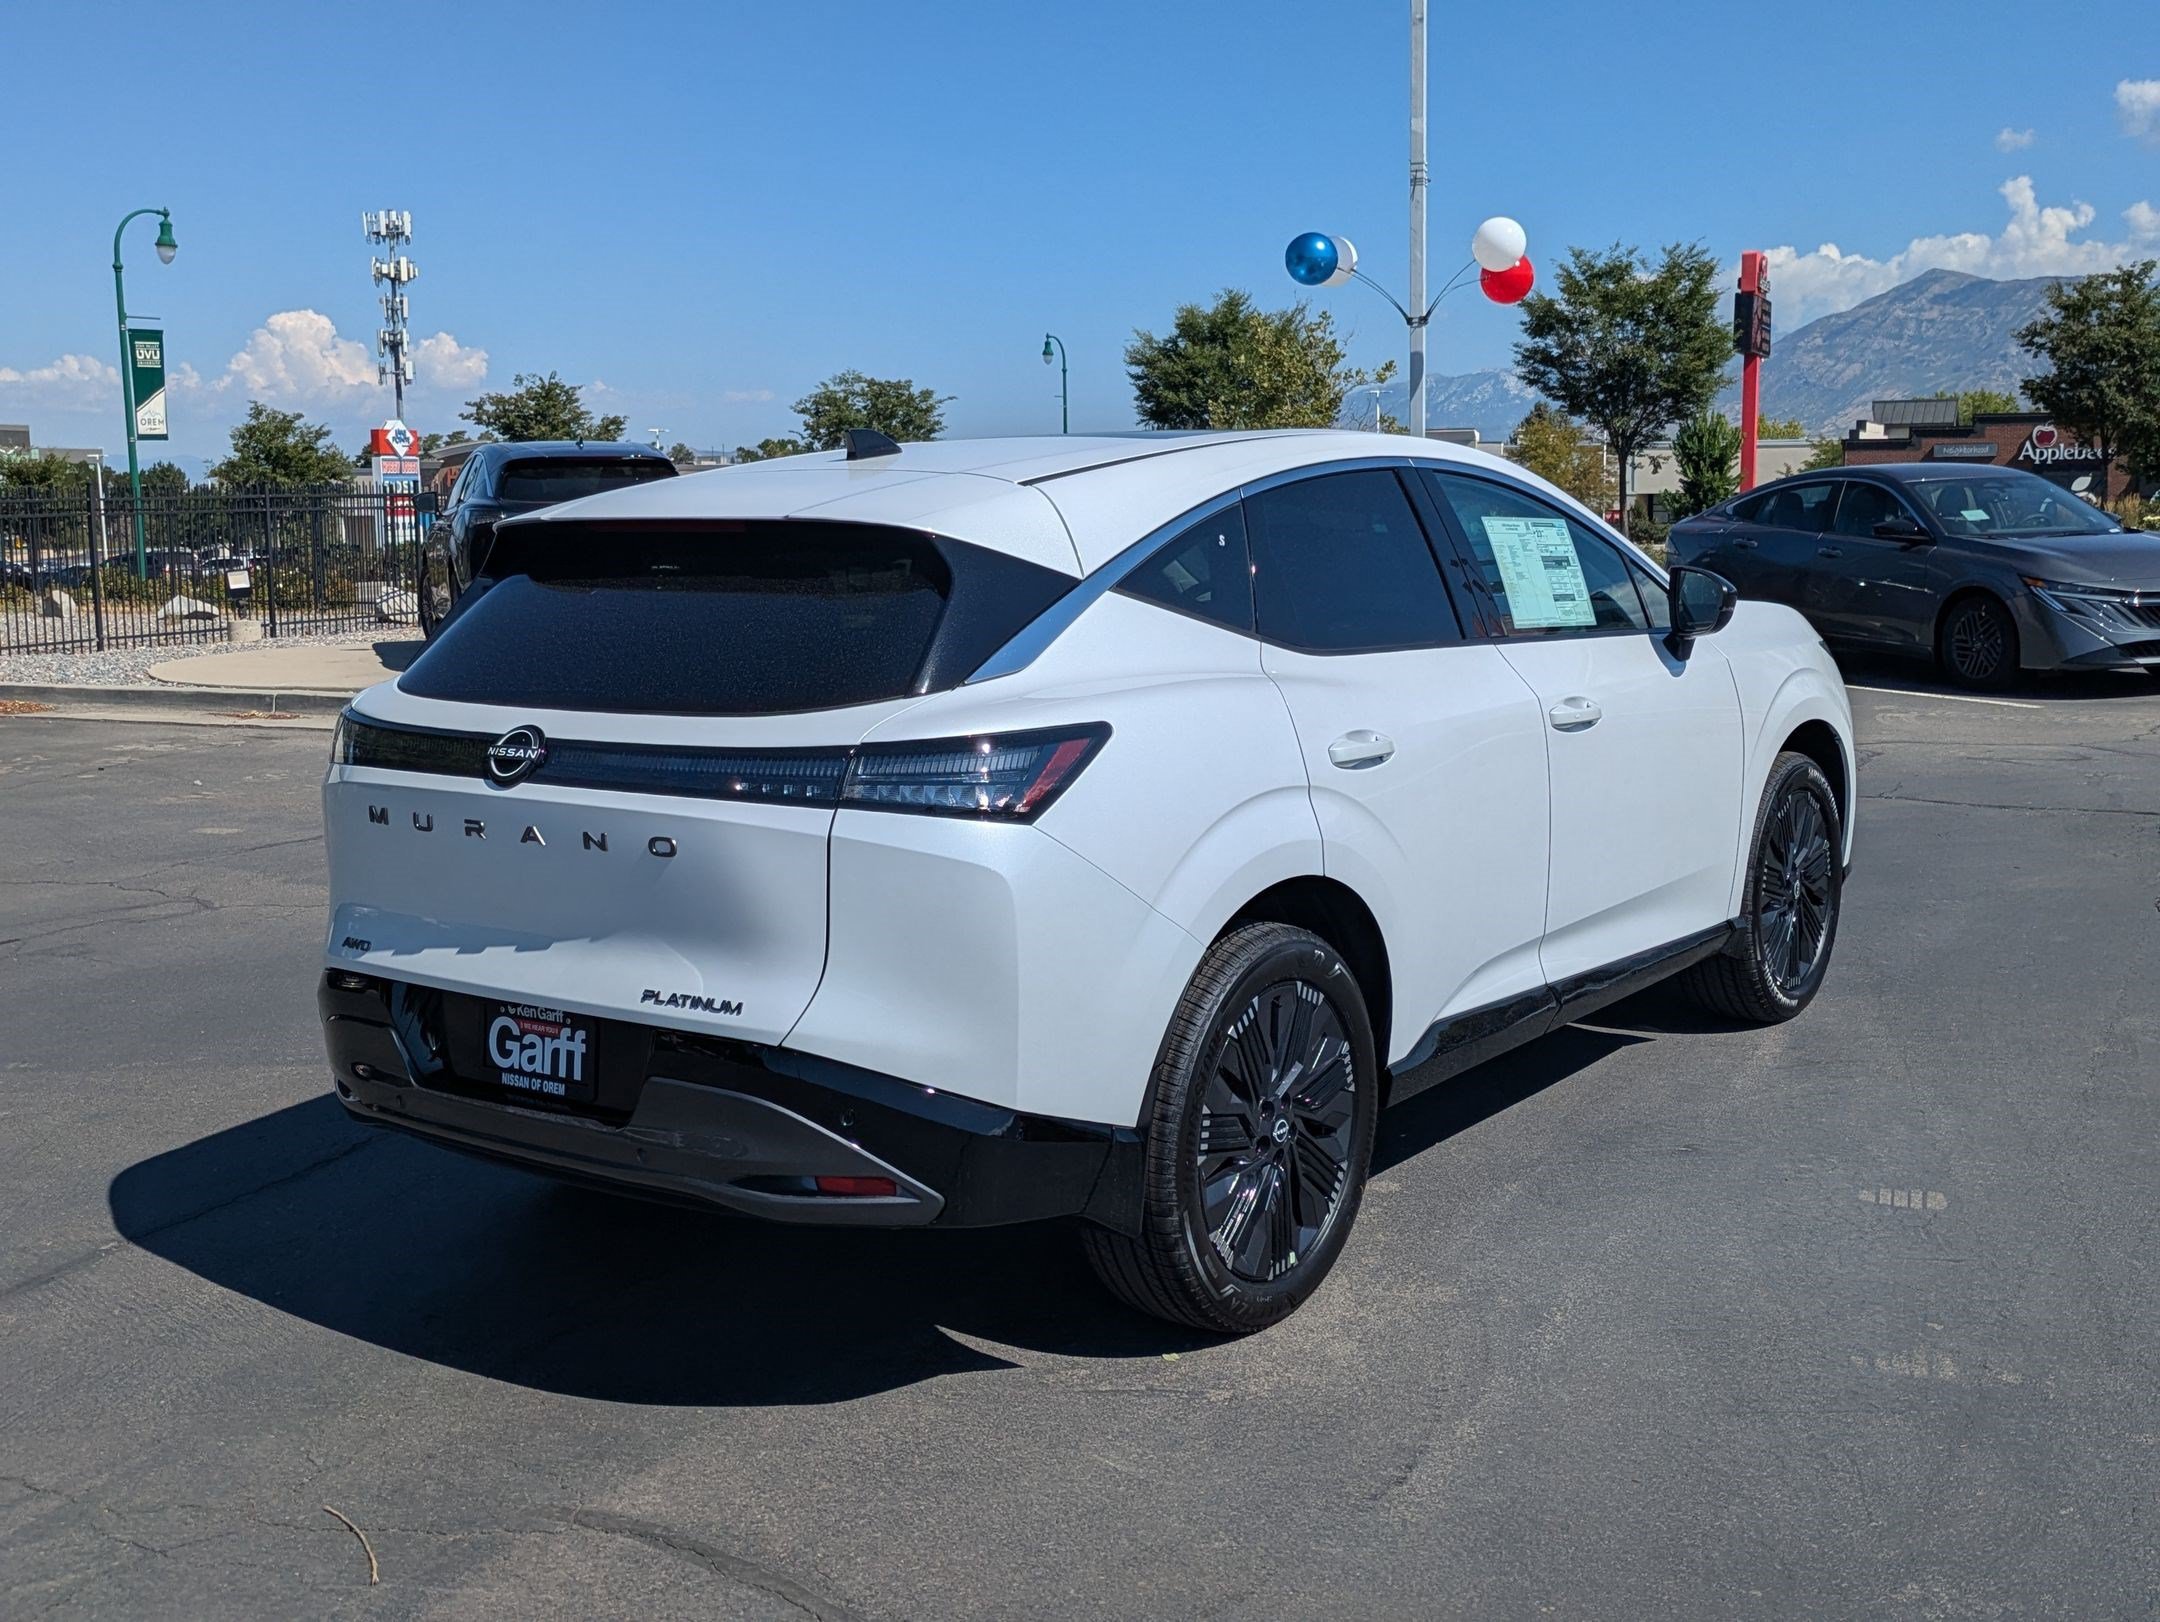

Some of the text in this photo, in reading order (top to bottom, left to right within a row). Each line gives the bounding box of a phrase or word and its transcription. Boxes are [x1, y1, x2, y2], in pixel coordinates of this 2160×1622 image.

[136, 349, 160, 359] UVU
[140, 418, 164, 426] OREM
[488, 746, 537, 759] NISSAN
[369, 805, 677, 858] MURANO
[342, 936, 371, 951] AWD
[641, 989, 744, 1016] PLATINUM
[517, 1005, 564, 1024] Ken Garff
[489, 1016, 586, 1081] Garff
[502, 1073, 565, 1096] NISSAN OF OREM
